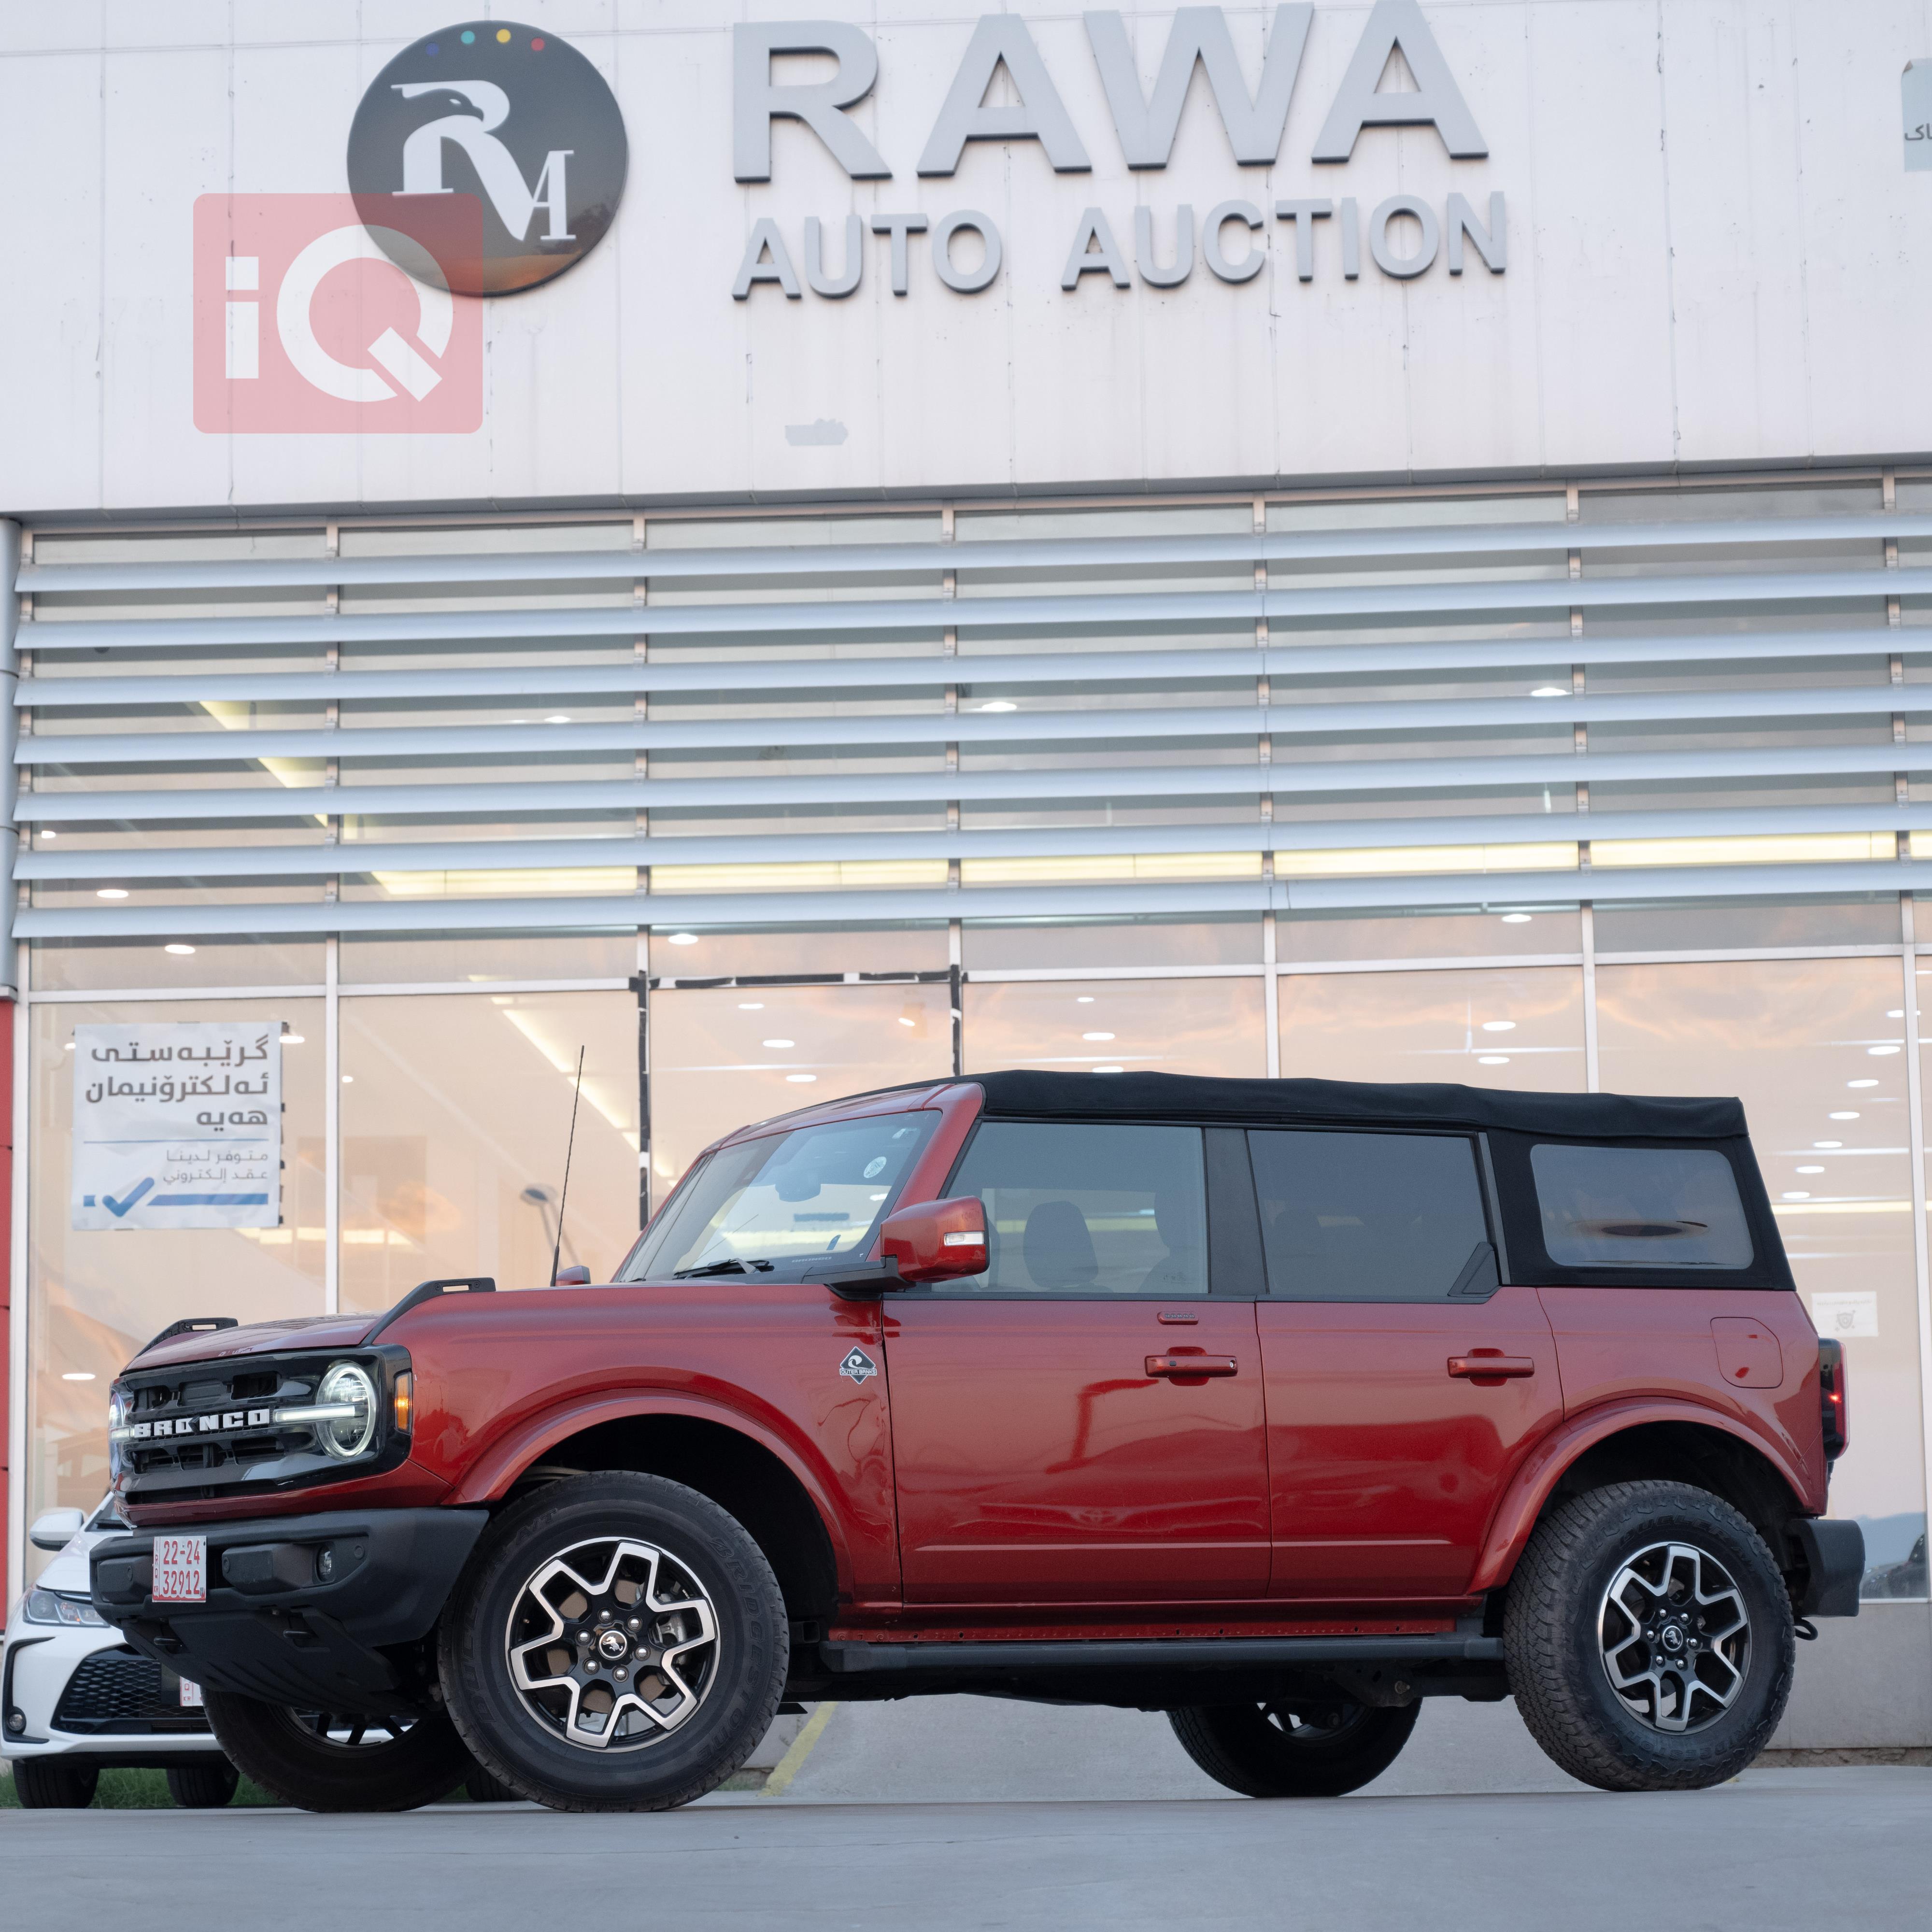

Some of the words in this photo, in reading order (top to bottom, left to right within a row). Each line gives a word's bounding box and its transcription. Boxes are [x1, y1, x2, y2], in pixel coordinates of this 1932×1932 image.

[733, 0, 1489, 184] RAWA
[731, 209, 1002, 300] AUTO
[1061, 190, 1507, 292] AUCTION
[166, 1149, 211, 1165] لدينا
[215, 1150, 269, 1165] متوفر
[163, 1167, 227, 1186] إلكتروني
[232, 1168, 268, 1180] عقد
[134, 1408, 270, 1438] BRONCO
[163, 1540, 200, 1564] 22-24
[163, 1570, 200, 1594] 32912
[696, 1537, 766, 1764] BRIDGESTONE
